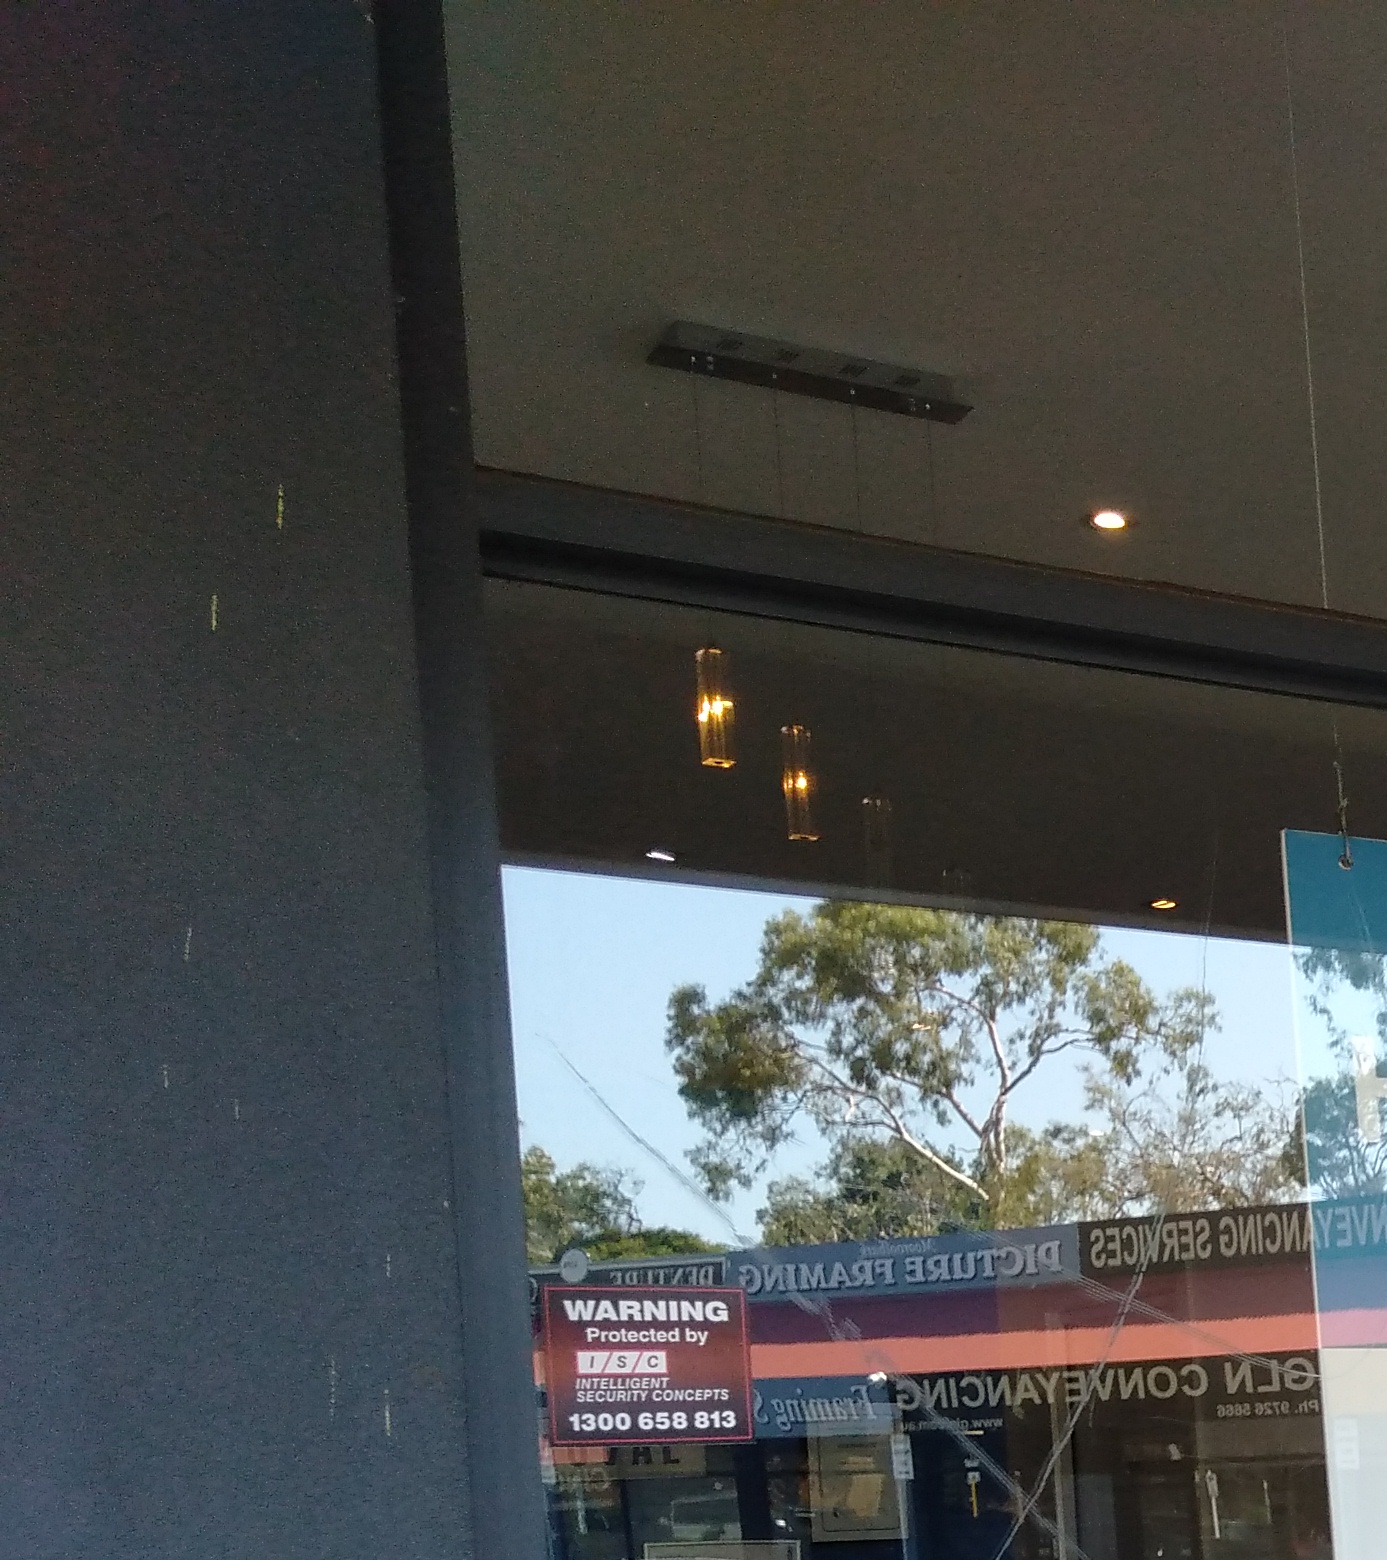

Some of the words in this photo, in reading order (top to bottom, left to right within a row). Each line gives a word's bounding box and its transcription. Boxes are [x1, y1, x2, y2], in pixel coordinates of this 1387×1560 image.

[563, 1300, 729, 1322] WARNING
[585, 1327, 680, 1343] Protected
[685, 1328, 708, 1346] by
[575, 1377, 670, 1390] INTELLIGENT
[576, 1390, 649, 1402] SECURITY
[652, 1389, 729, 1401] CONCEPTS
[569, 1413, 631, 1431] 1300
[638, 1412, 688, 1430] 658
[694, 1411, 736, 1429] 813
